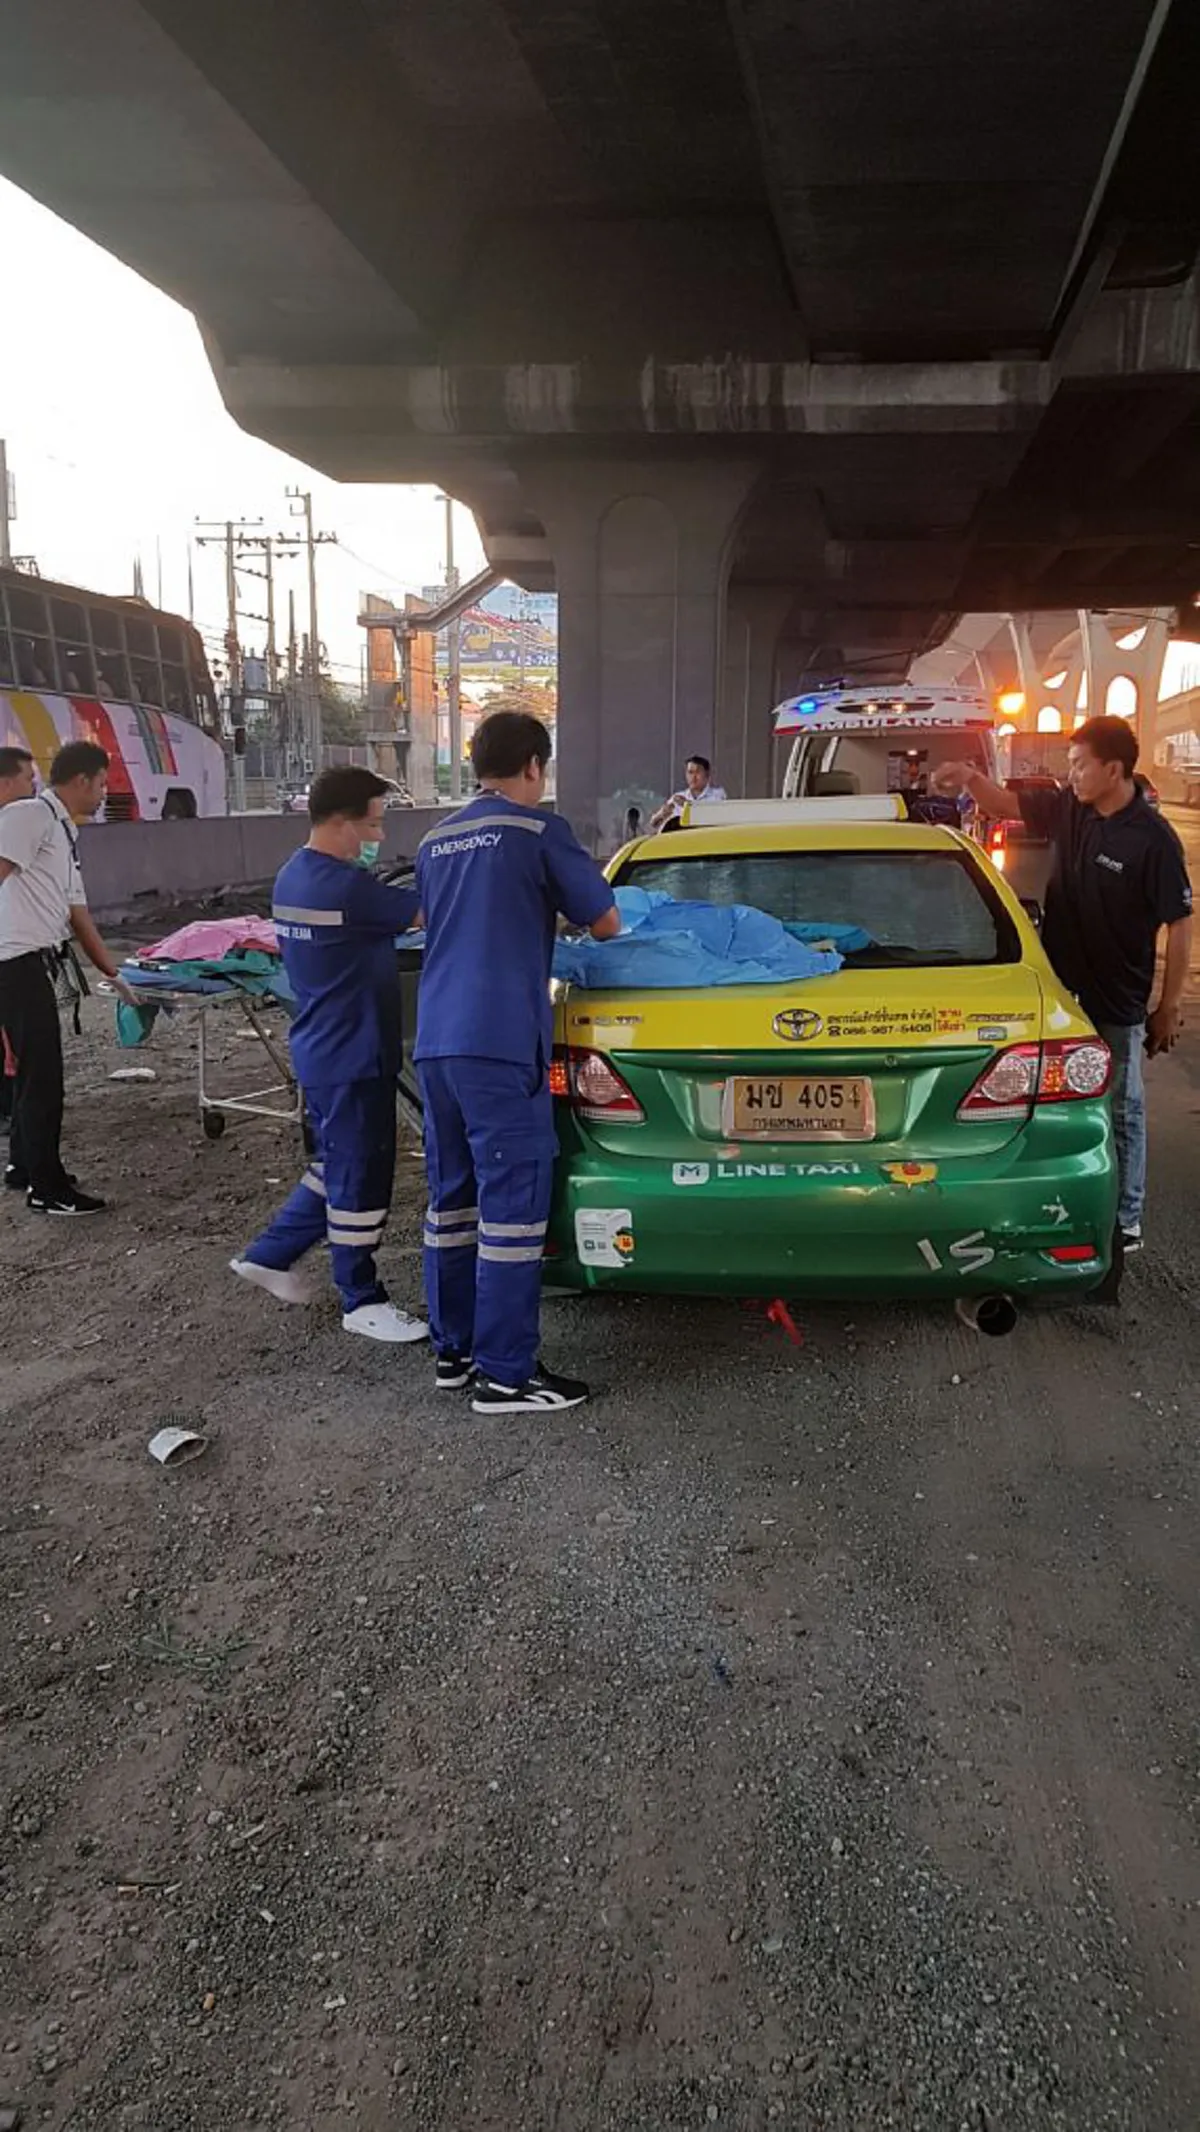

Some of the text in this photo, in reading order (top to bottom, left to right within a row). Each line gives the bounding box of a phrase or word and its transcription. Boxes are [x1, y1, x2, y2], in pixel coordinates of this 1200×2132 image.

[802, 717, 966, 731] AMBULANCE
[431, 832, 502, 857] EMERGENCY
[717, 1162, 862, 1178] LINE TAXI
